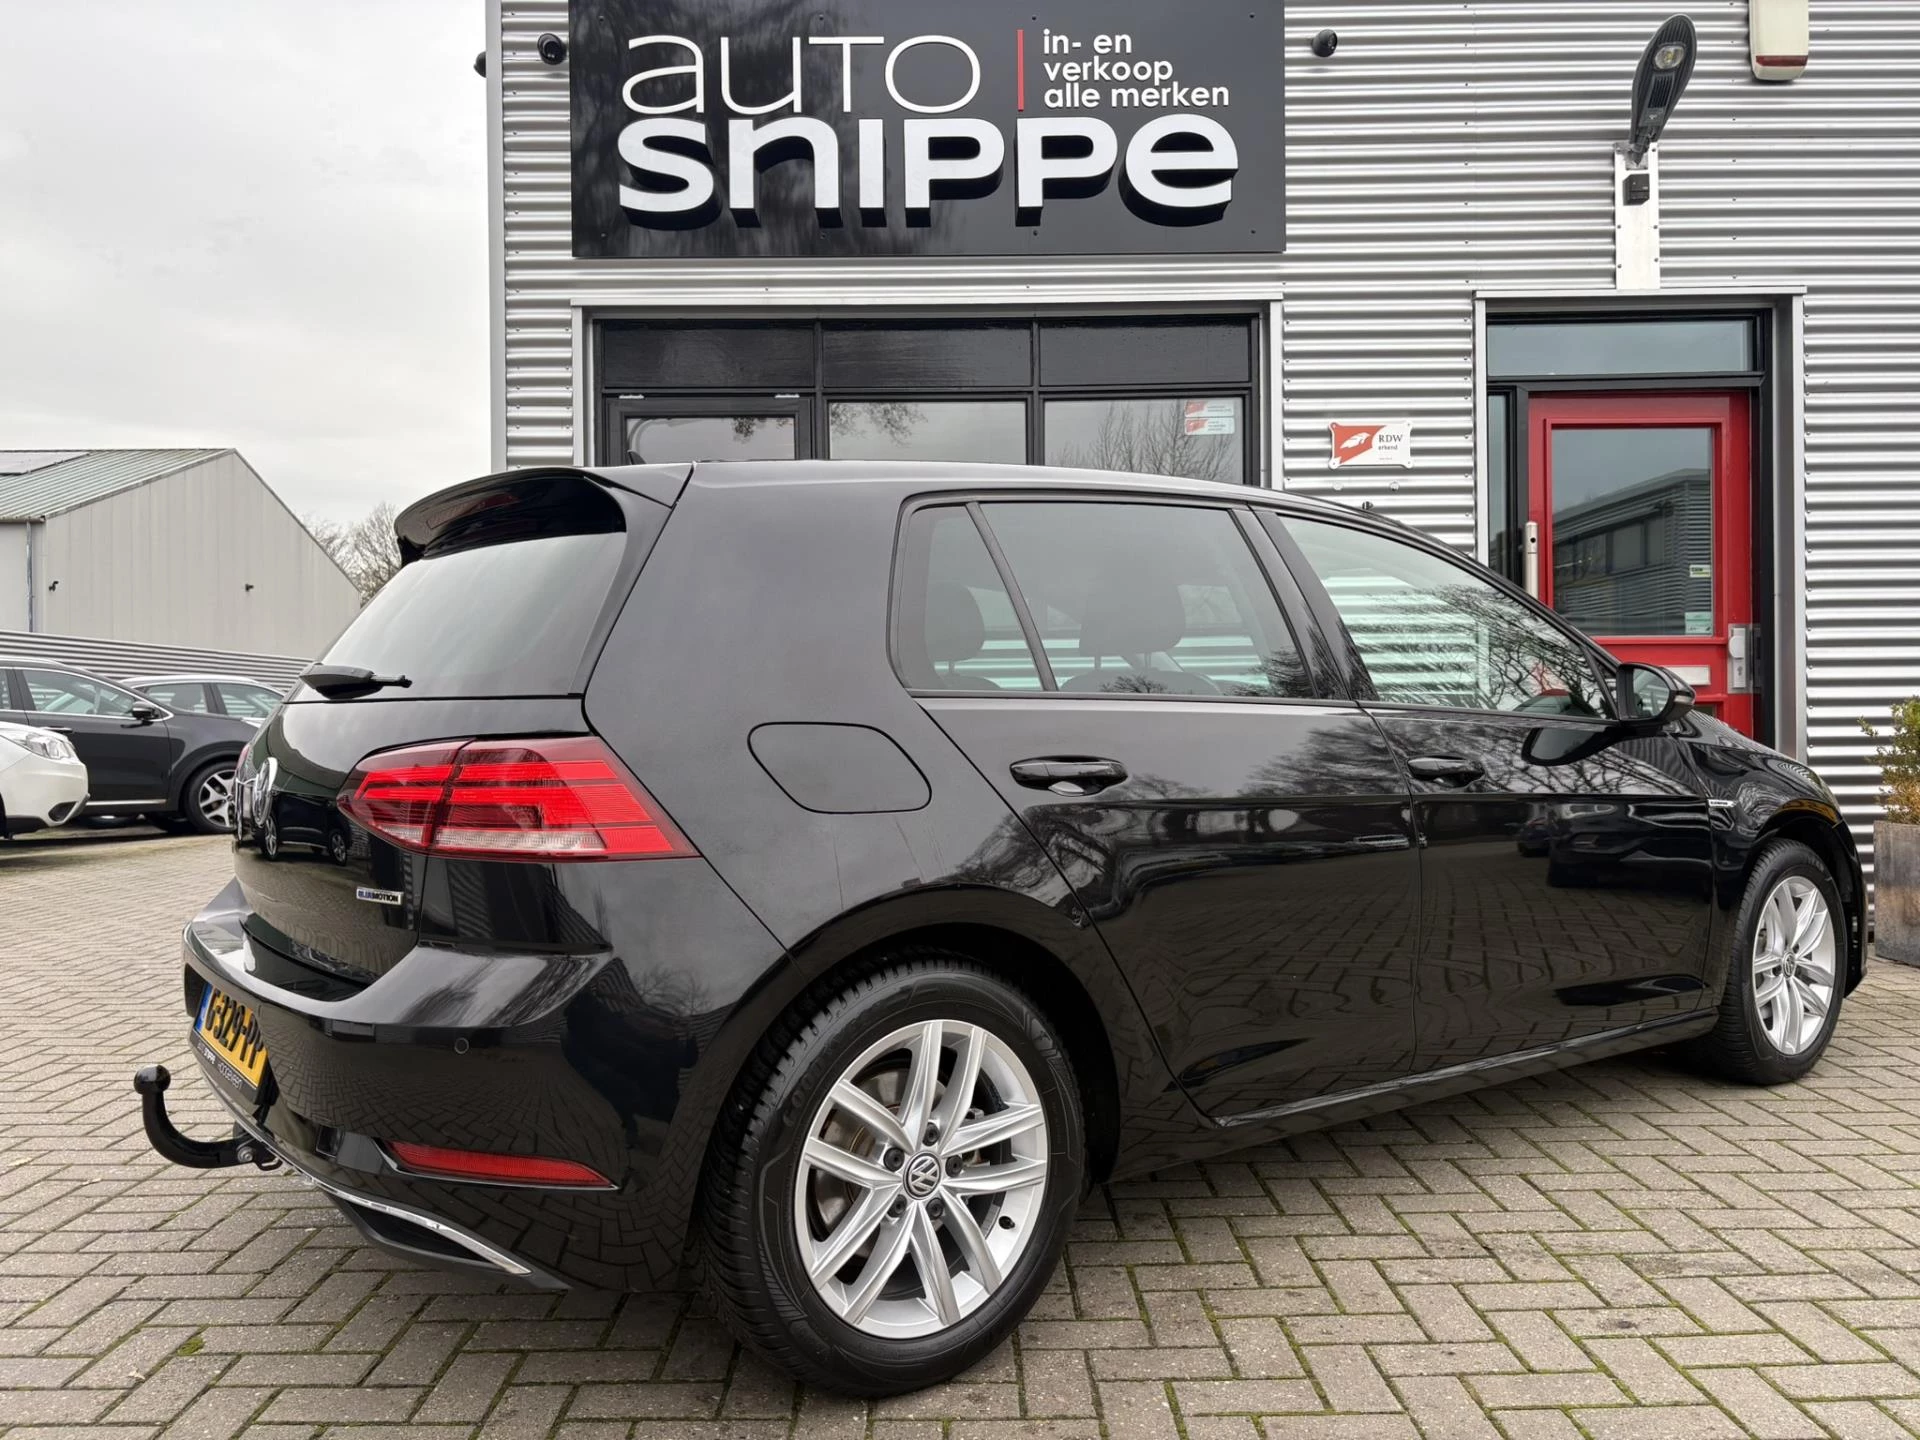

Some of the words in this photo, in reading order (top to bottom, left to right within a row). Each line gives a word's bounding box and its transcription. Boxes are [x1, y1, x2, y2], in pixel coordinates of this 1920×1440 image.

[1043, 28, 1082, 54] in-
[1093, 33, 1132, 54] en
[1043, 55, 1173, 86] verkoop
[1044, 82, 1101, 108] alle
[1111, 81, 1230, 107] merken
[1378, 434, 1403, 443] RDW
